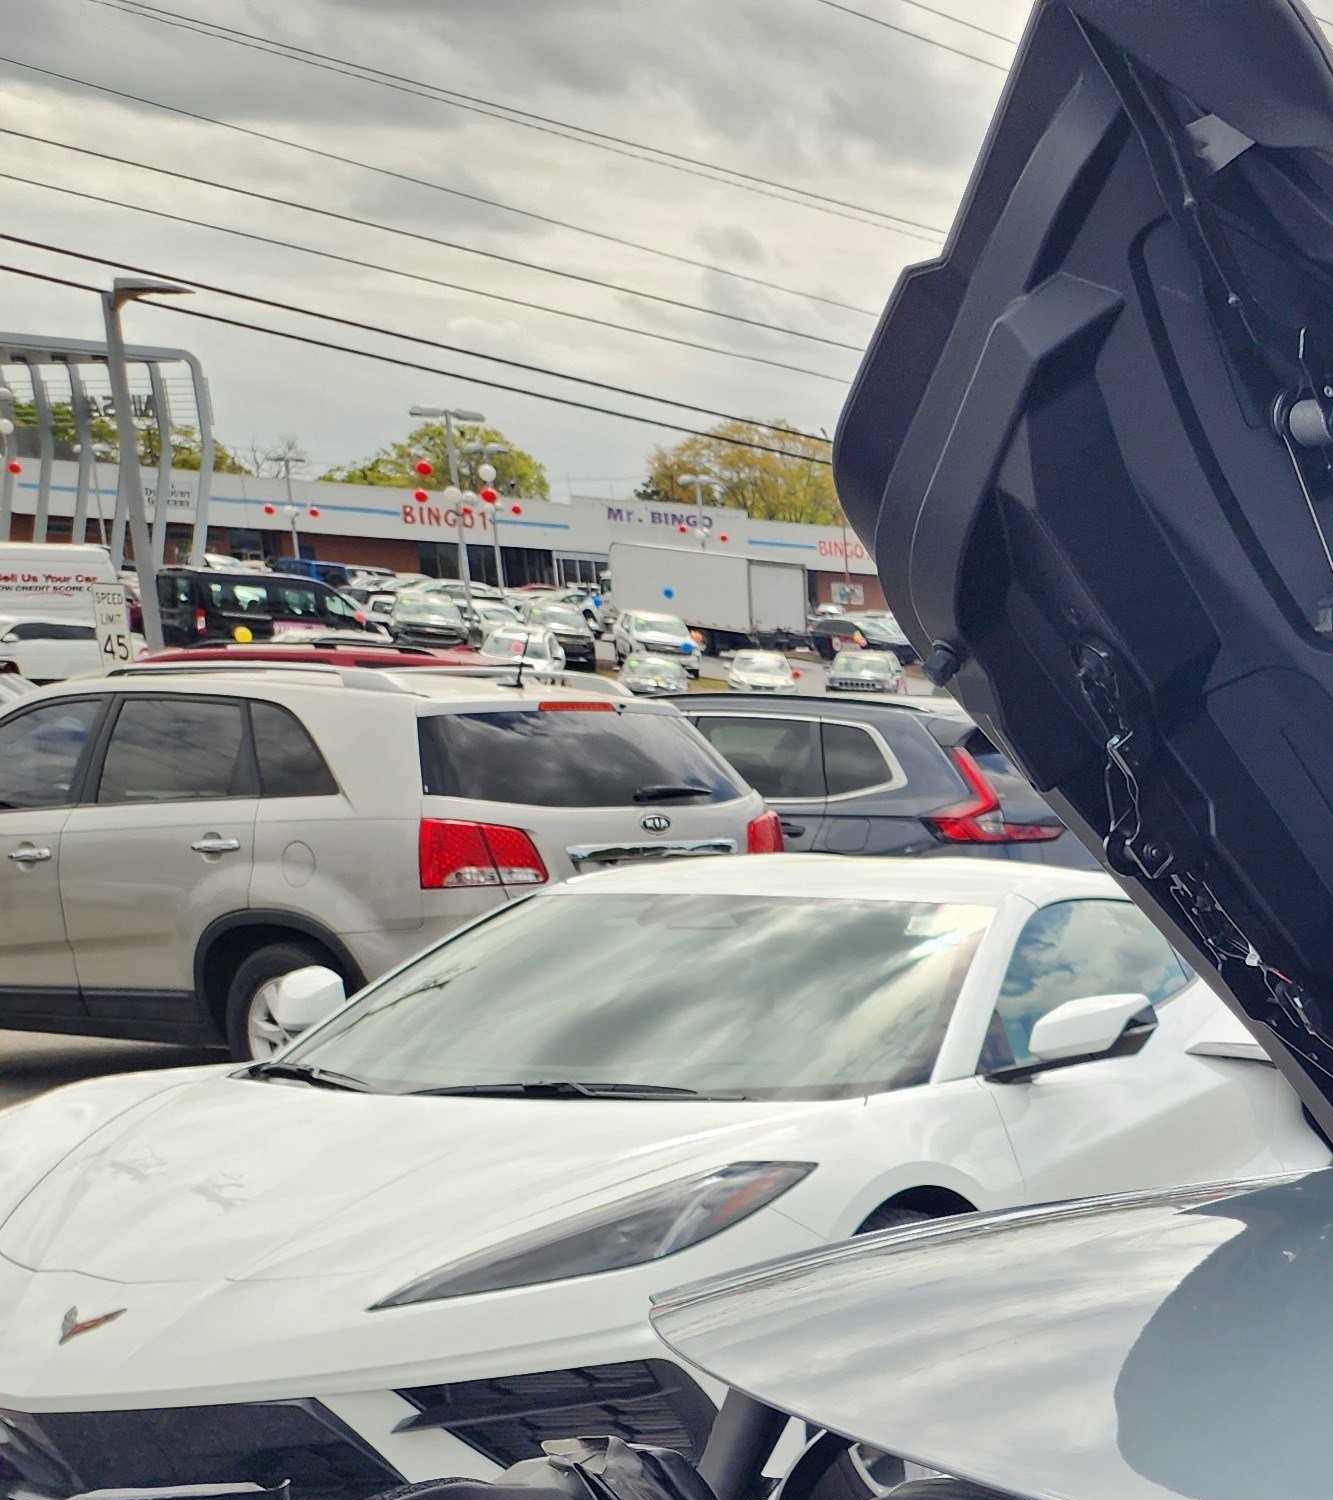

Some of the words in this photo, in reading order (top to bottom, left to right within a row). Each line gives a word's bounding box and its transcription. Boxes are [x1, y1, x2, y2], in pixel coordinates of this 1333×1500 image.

[651, 511, 713, 528] BINGO
[21, 573, 39, 583] Us
[43, 573, 71, 583] Your
[75, 574, 97, 583] Car
[95, 591, 123, 605] SPEED
[103, 633, 129, 661] 45
